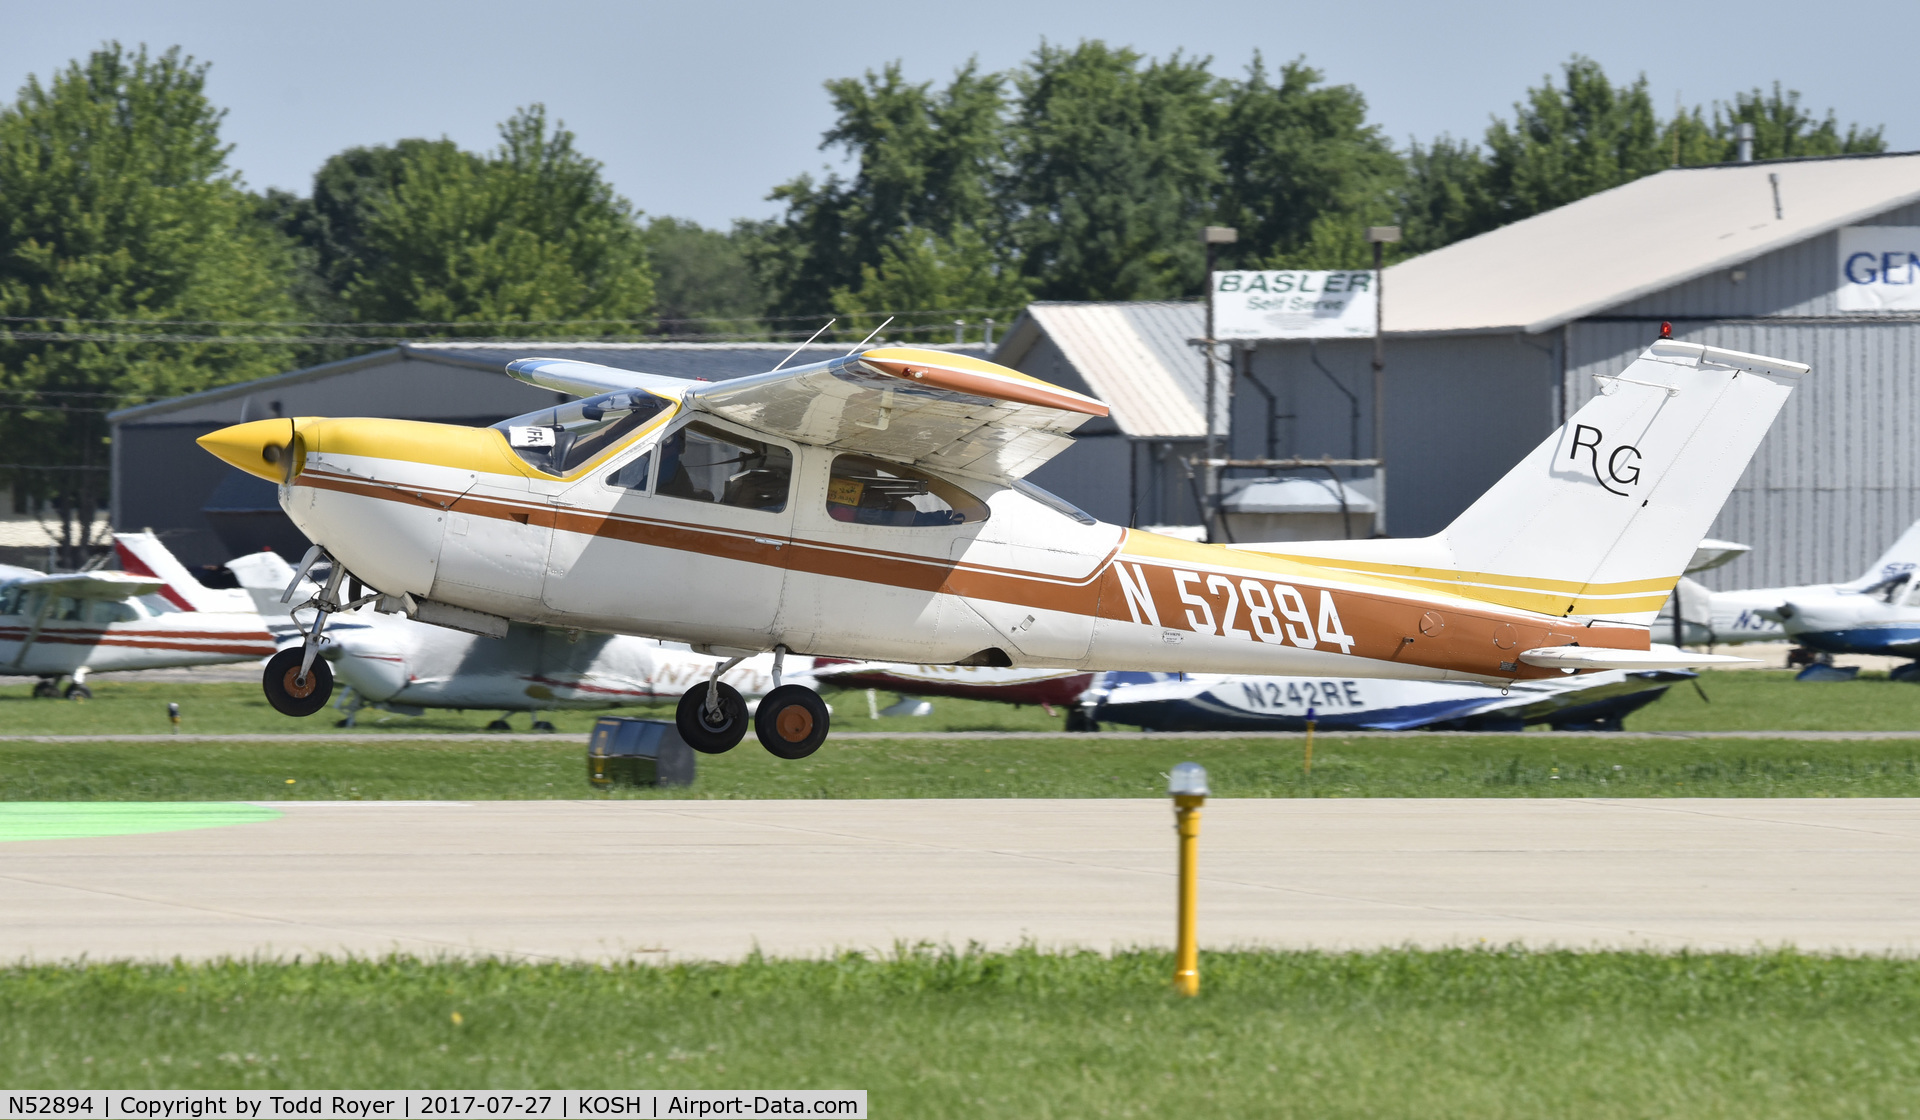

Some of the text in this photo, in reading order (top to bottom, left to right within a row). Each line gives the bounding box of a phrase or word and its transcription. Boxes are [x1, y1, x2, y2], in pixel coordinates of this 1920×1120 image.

[1219, 273, 1373, 293] BASLER
[1247, 296, 1286, 311] Self
[1570, 424, 1642, 496] RG
[1113, 561, 1355, 655] N 52894
[1242, 681, 1364, 707] N242RE
